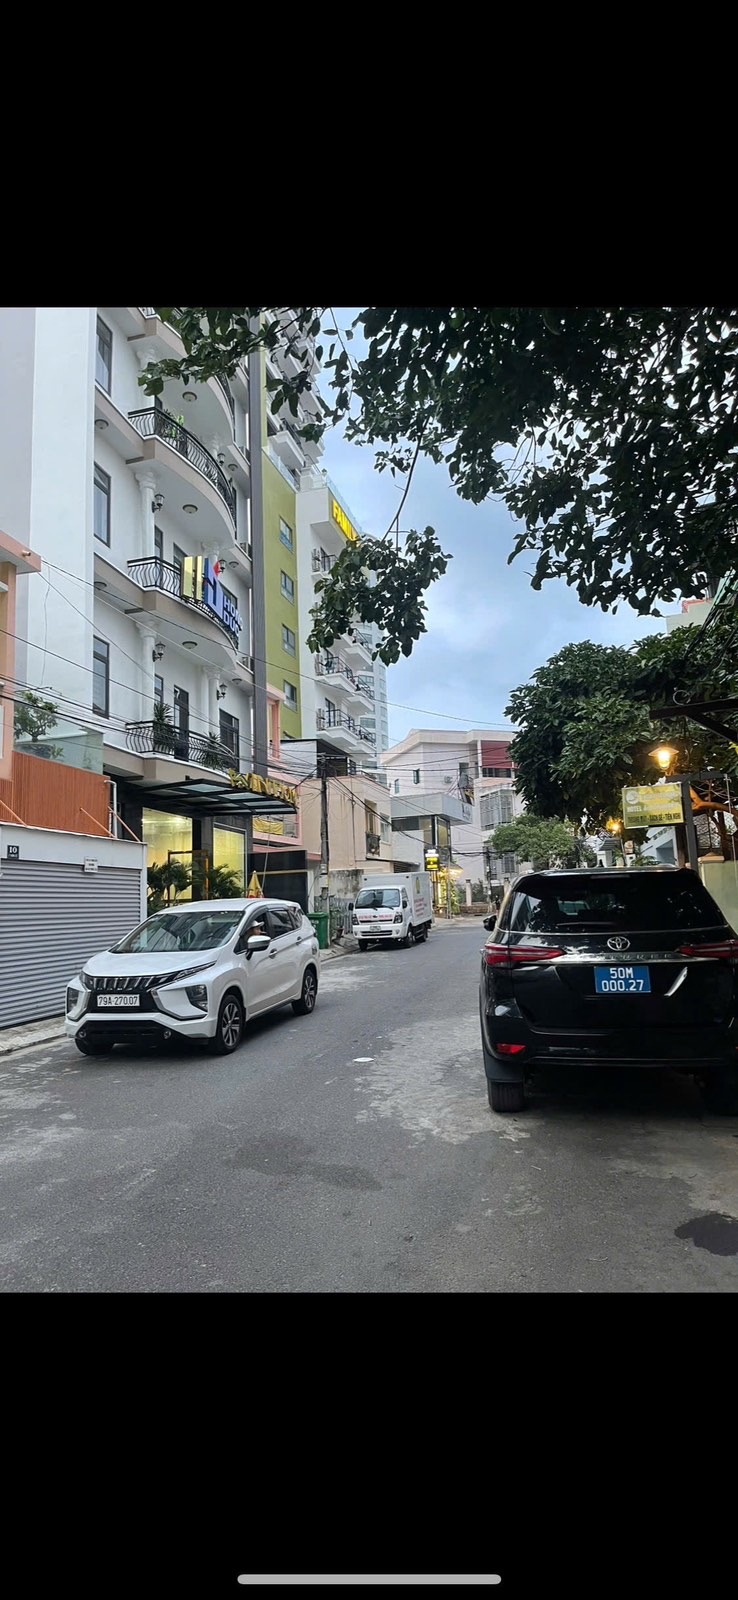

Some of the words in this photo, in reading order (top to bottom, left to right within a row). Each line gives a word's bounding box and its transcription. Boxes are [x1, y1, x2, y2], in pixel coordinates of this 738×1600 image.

[9, 846, 18, 854] 10
[610, 967, 634, 979] 50M
[601, 979, 645, 992] 000.27
[98, 996, 138, 1005] 79A-270.07
